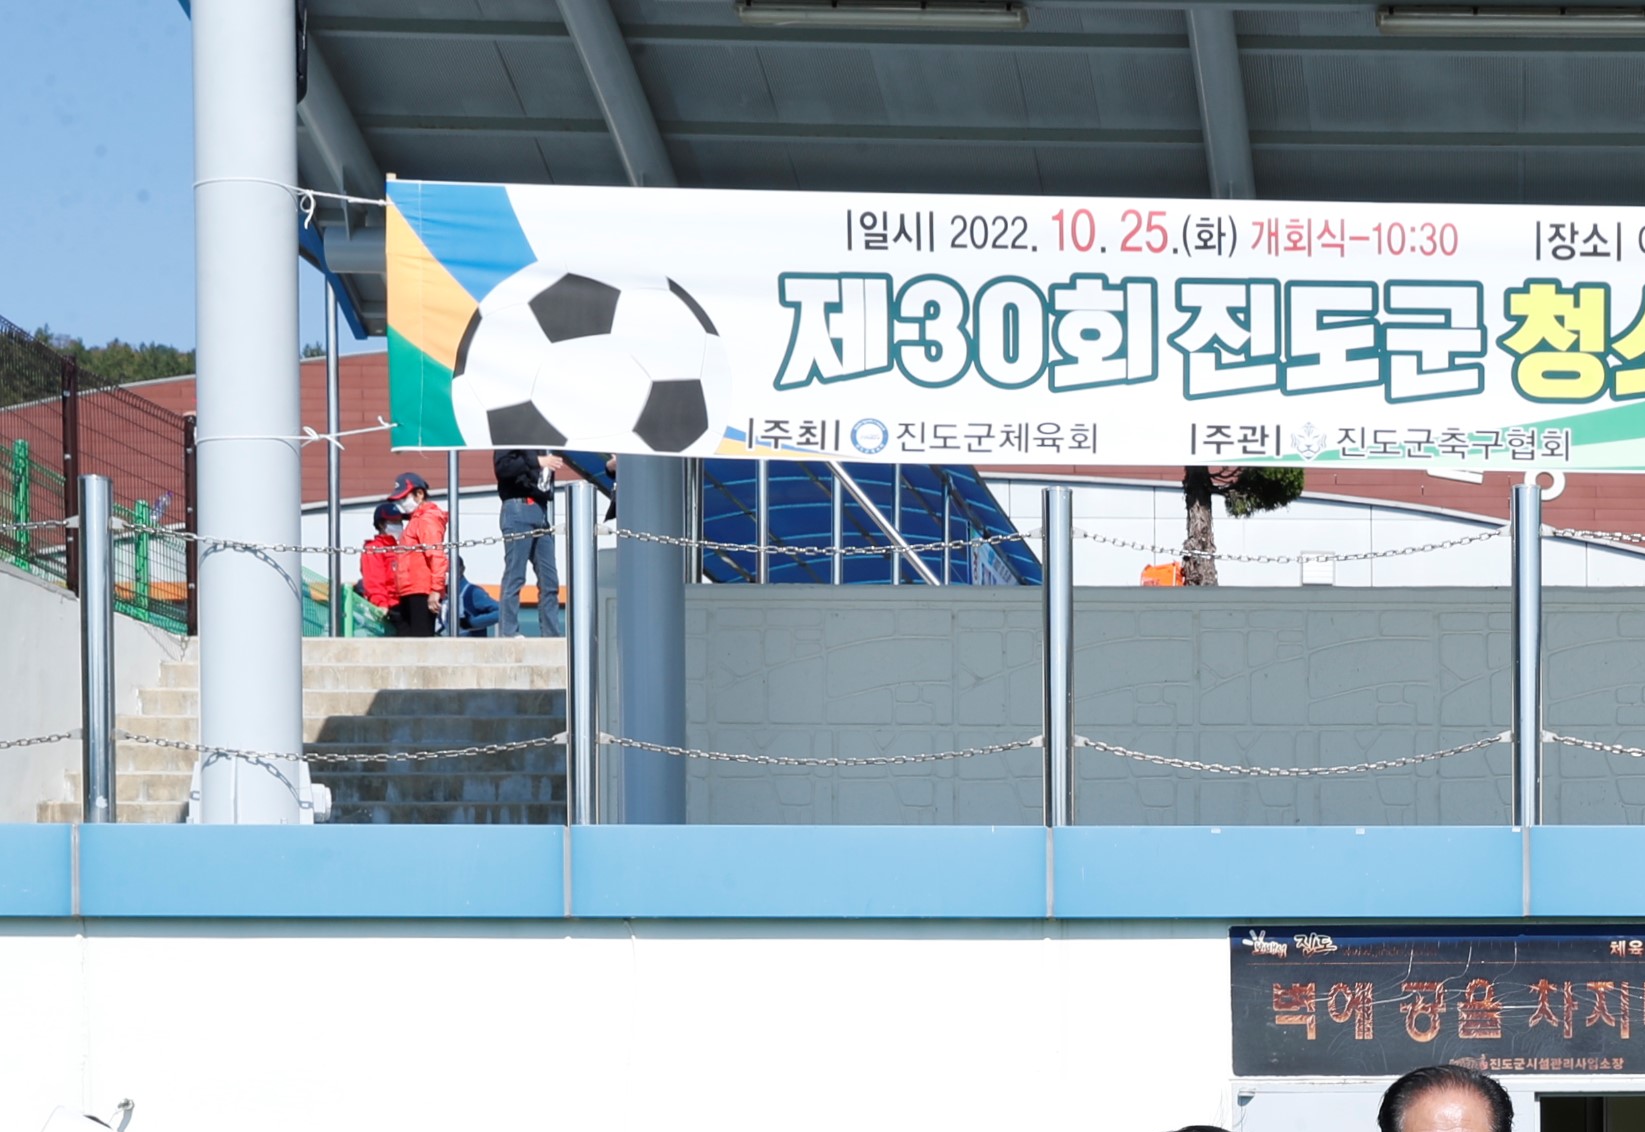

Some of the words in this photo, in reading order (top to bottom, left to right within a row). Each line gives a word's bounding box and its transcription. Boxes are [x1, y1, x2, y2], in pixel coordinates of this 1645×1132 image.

[949, 214, 1040, 252] 2022.
[1051, 208, 1108, 254] 10.
[773, 271, 1159, 393] 제30회
[1167, 276, 1487, 404] 진도군
[894, 421, 1099, 455] 진도군체육회
[1335, 426, 1570, 462] 진도군축구협회
[1271, 981, 1375, 1042] 벽에
[1399, 978, 1503, 1043] 공을
